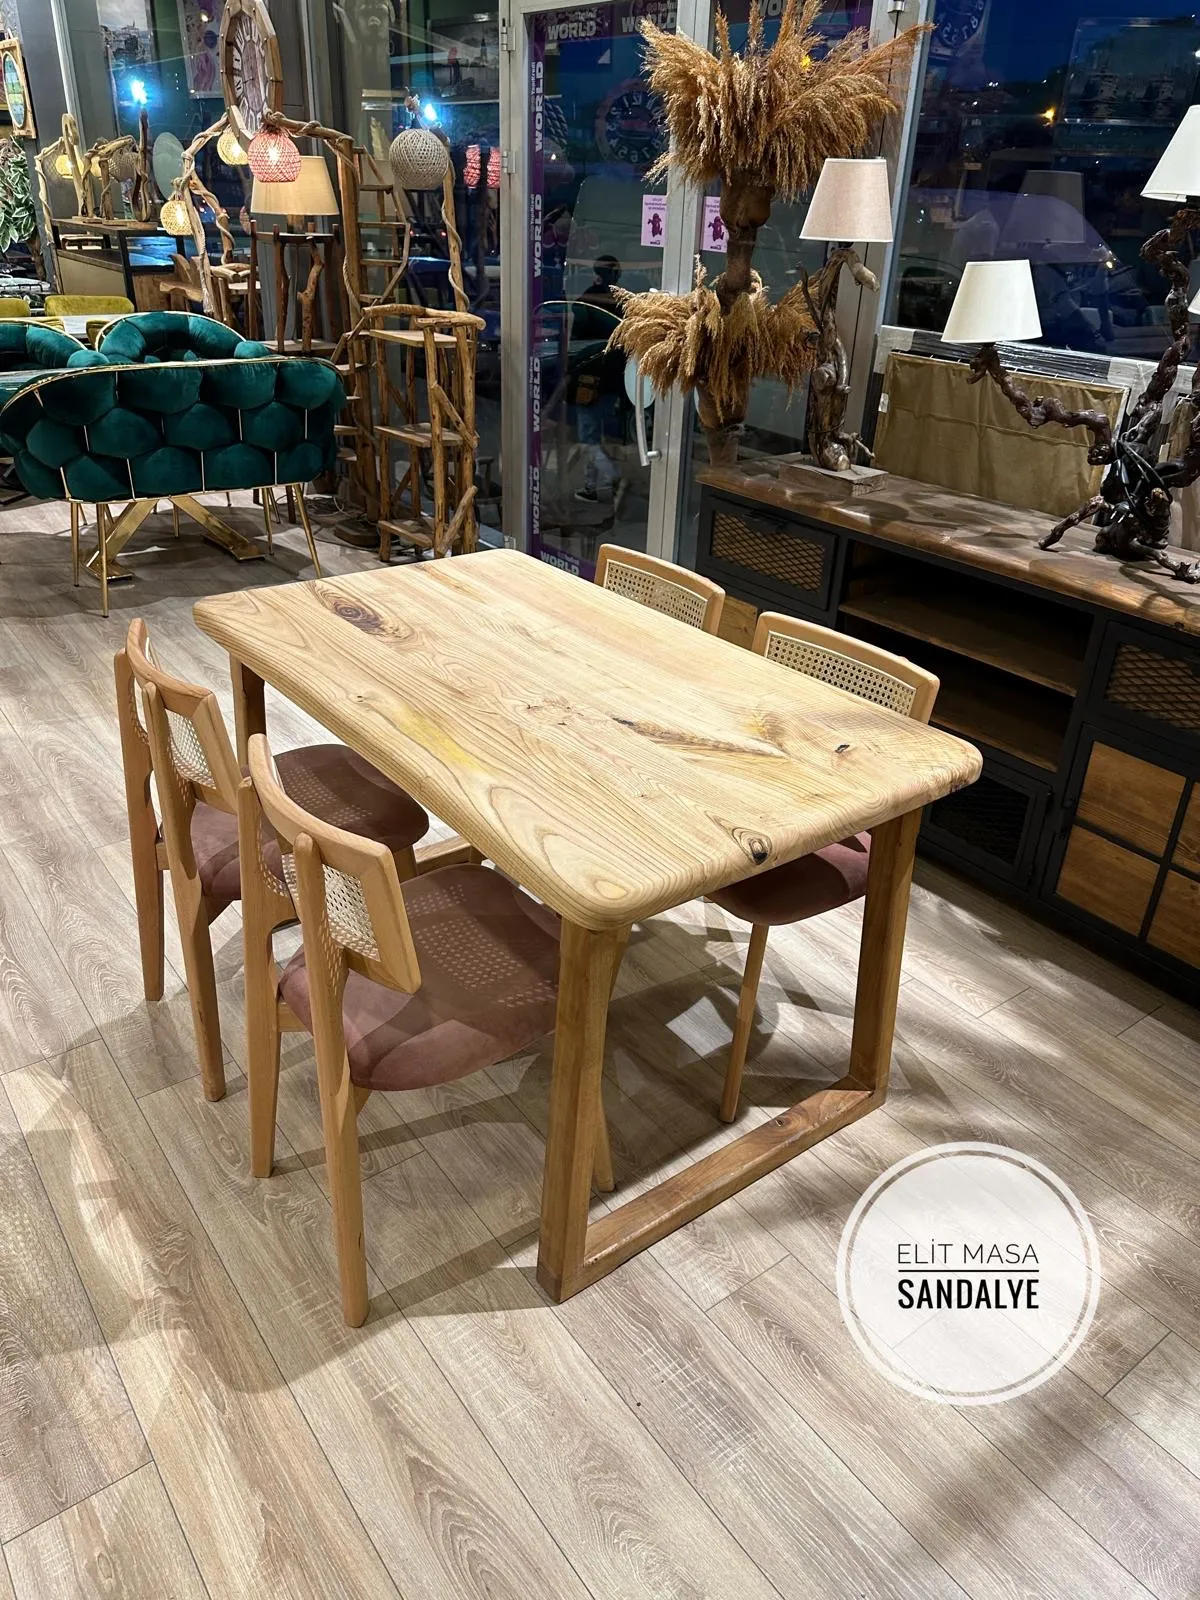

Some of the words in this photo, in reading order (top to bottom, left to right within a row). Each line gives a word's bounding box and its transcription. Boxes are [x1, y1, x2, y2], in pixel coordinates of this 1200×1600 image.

[548, 20, 597, 40] WORLD
[535, 61, 544, 152] WORLD
[534, 194, 542, 278] WORLD
[533, 357, 541, 433] WORLD
[532, 467, 540, 535] WORLD
[540, 550, 580, 575] WORLD
